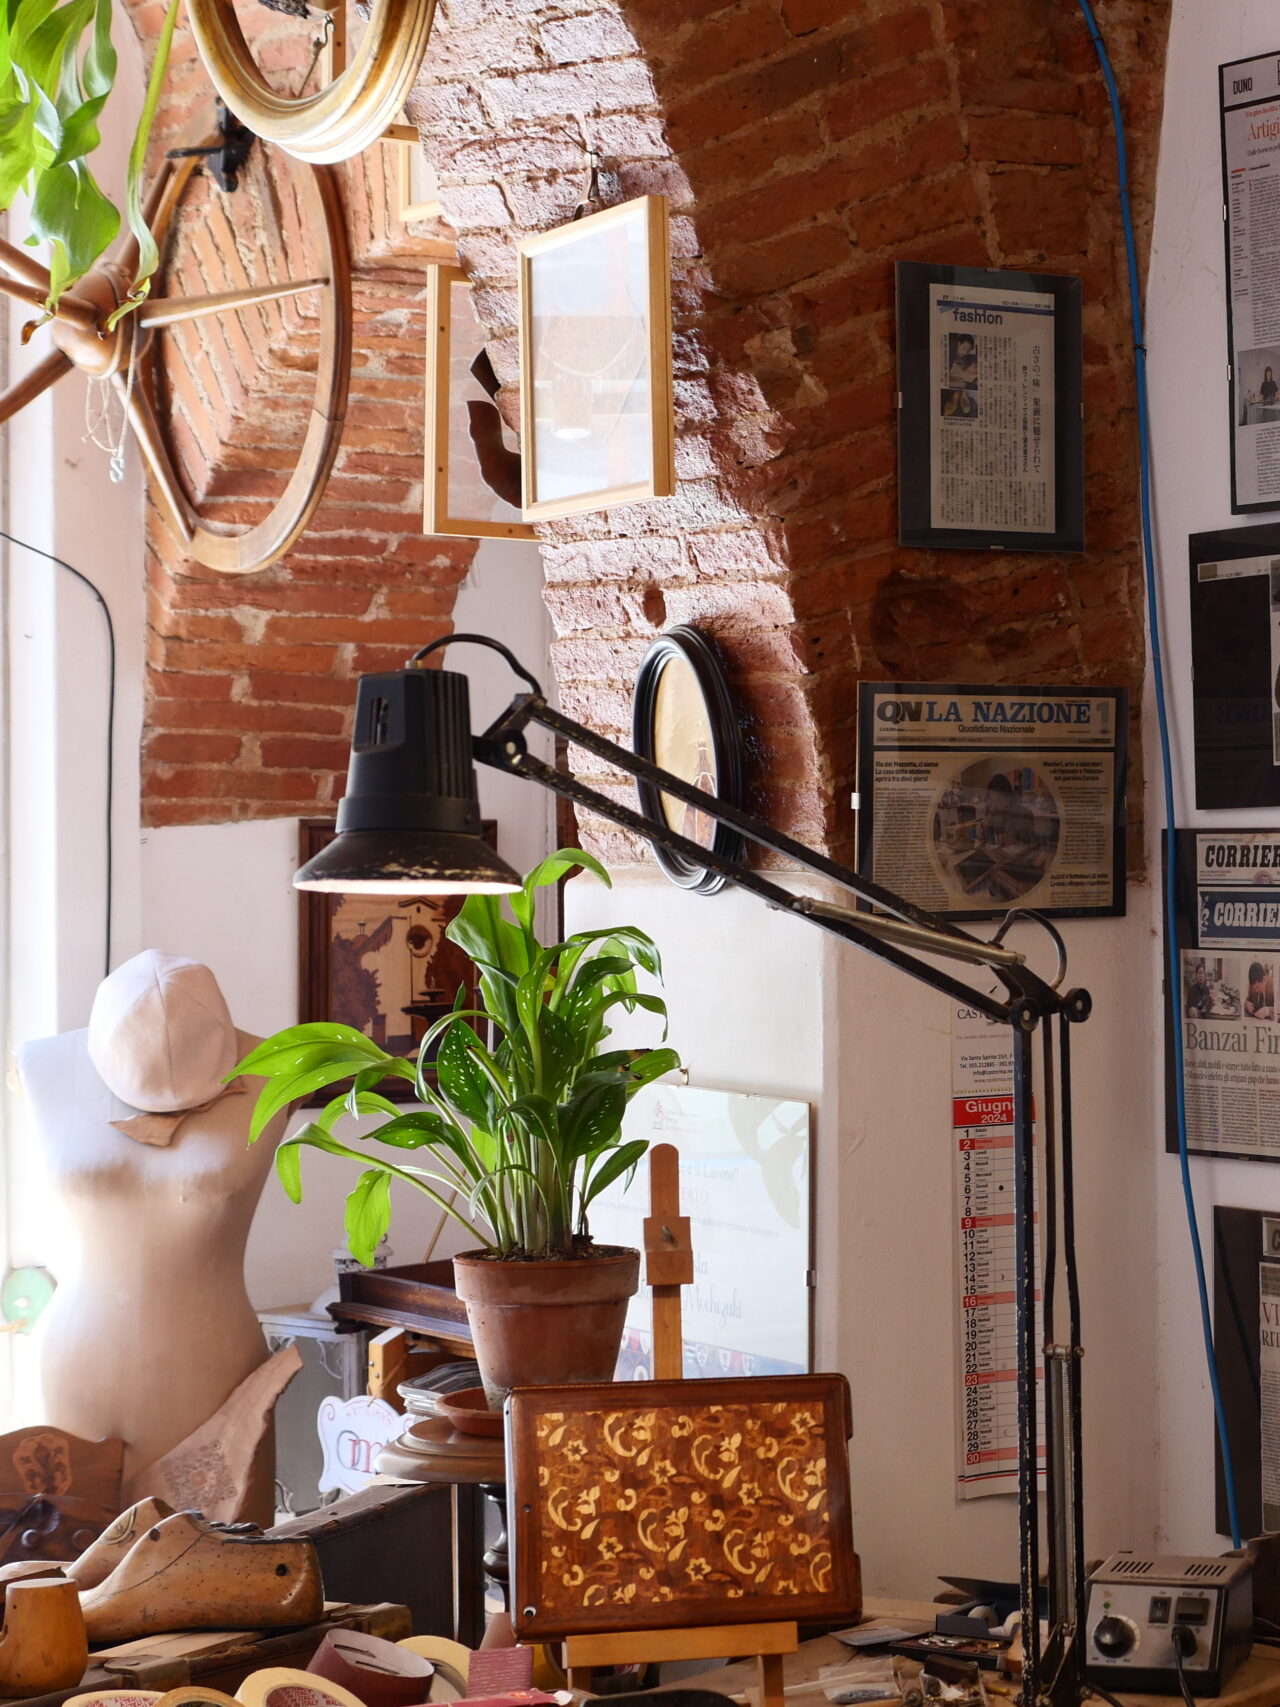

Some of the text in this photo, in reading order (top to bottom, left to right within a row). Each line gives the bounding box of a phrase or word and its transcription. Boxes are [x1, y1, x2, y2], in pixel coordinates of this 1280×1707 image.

[1233, 77, 1253, 95] DUNO
[953, 307, 1003, 325] fashion
[877, 700, 1091, 724] QN LA NAZIONE
[958, 724, 1035, 734] Quotidiano Nazionale
[1184, 1022, 1248, 1053] Banzai
[981, 1113, 1007, 1123] 2024
[965, 1129, 969, 1138] 1
[963, 1140, 971, 1150] 2
[963, 1151, 971, 1161] 3
[963, 1162, 971, 1171] 4
[964, 1173, 971, 1183] 5
[964, 1184, 971, 1194] 6
[964, 1196, 971, 1206] 7
[964, 1207, 971, 1217] 8
[965, 1218, 971, 1228] 9
[963, 1229, 975, 1239] 10
[963, 1241, 975, 1250] 11
[963, 1251, 975, 1261] 12
[964, 1263, 976, 1272] 13
[964, 1274, 976, 1283] 14
[964, 1285, 976, 1295] 15
[965, 1296, 976, 1306] 16
[964, 1308, 976, 1317] 17
[965, 1318, 977, 1329] 18
[965, 1330, 977, 1340] 19
[964, 1340, 977, 1351] 20
[965, 1352, 976, 1363] 21
[965, 1364, 977, 1374] 22
[966, 1375, 978, 1385] 23
[965, 1386, 978, 1396] 24
[966, 1397, 978, 1408] 25
[966, 1408, 978, 1419] 26
[966, 1420, 978, 1430] 27
[967, 1431, 978, 1441] 28
[967, 1442, 979, 1453] 29
[967, 1453, 979, 1464] 30
